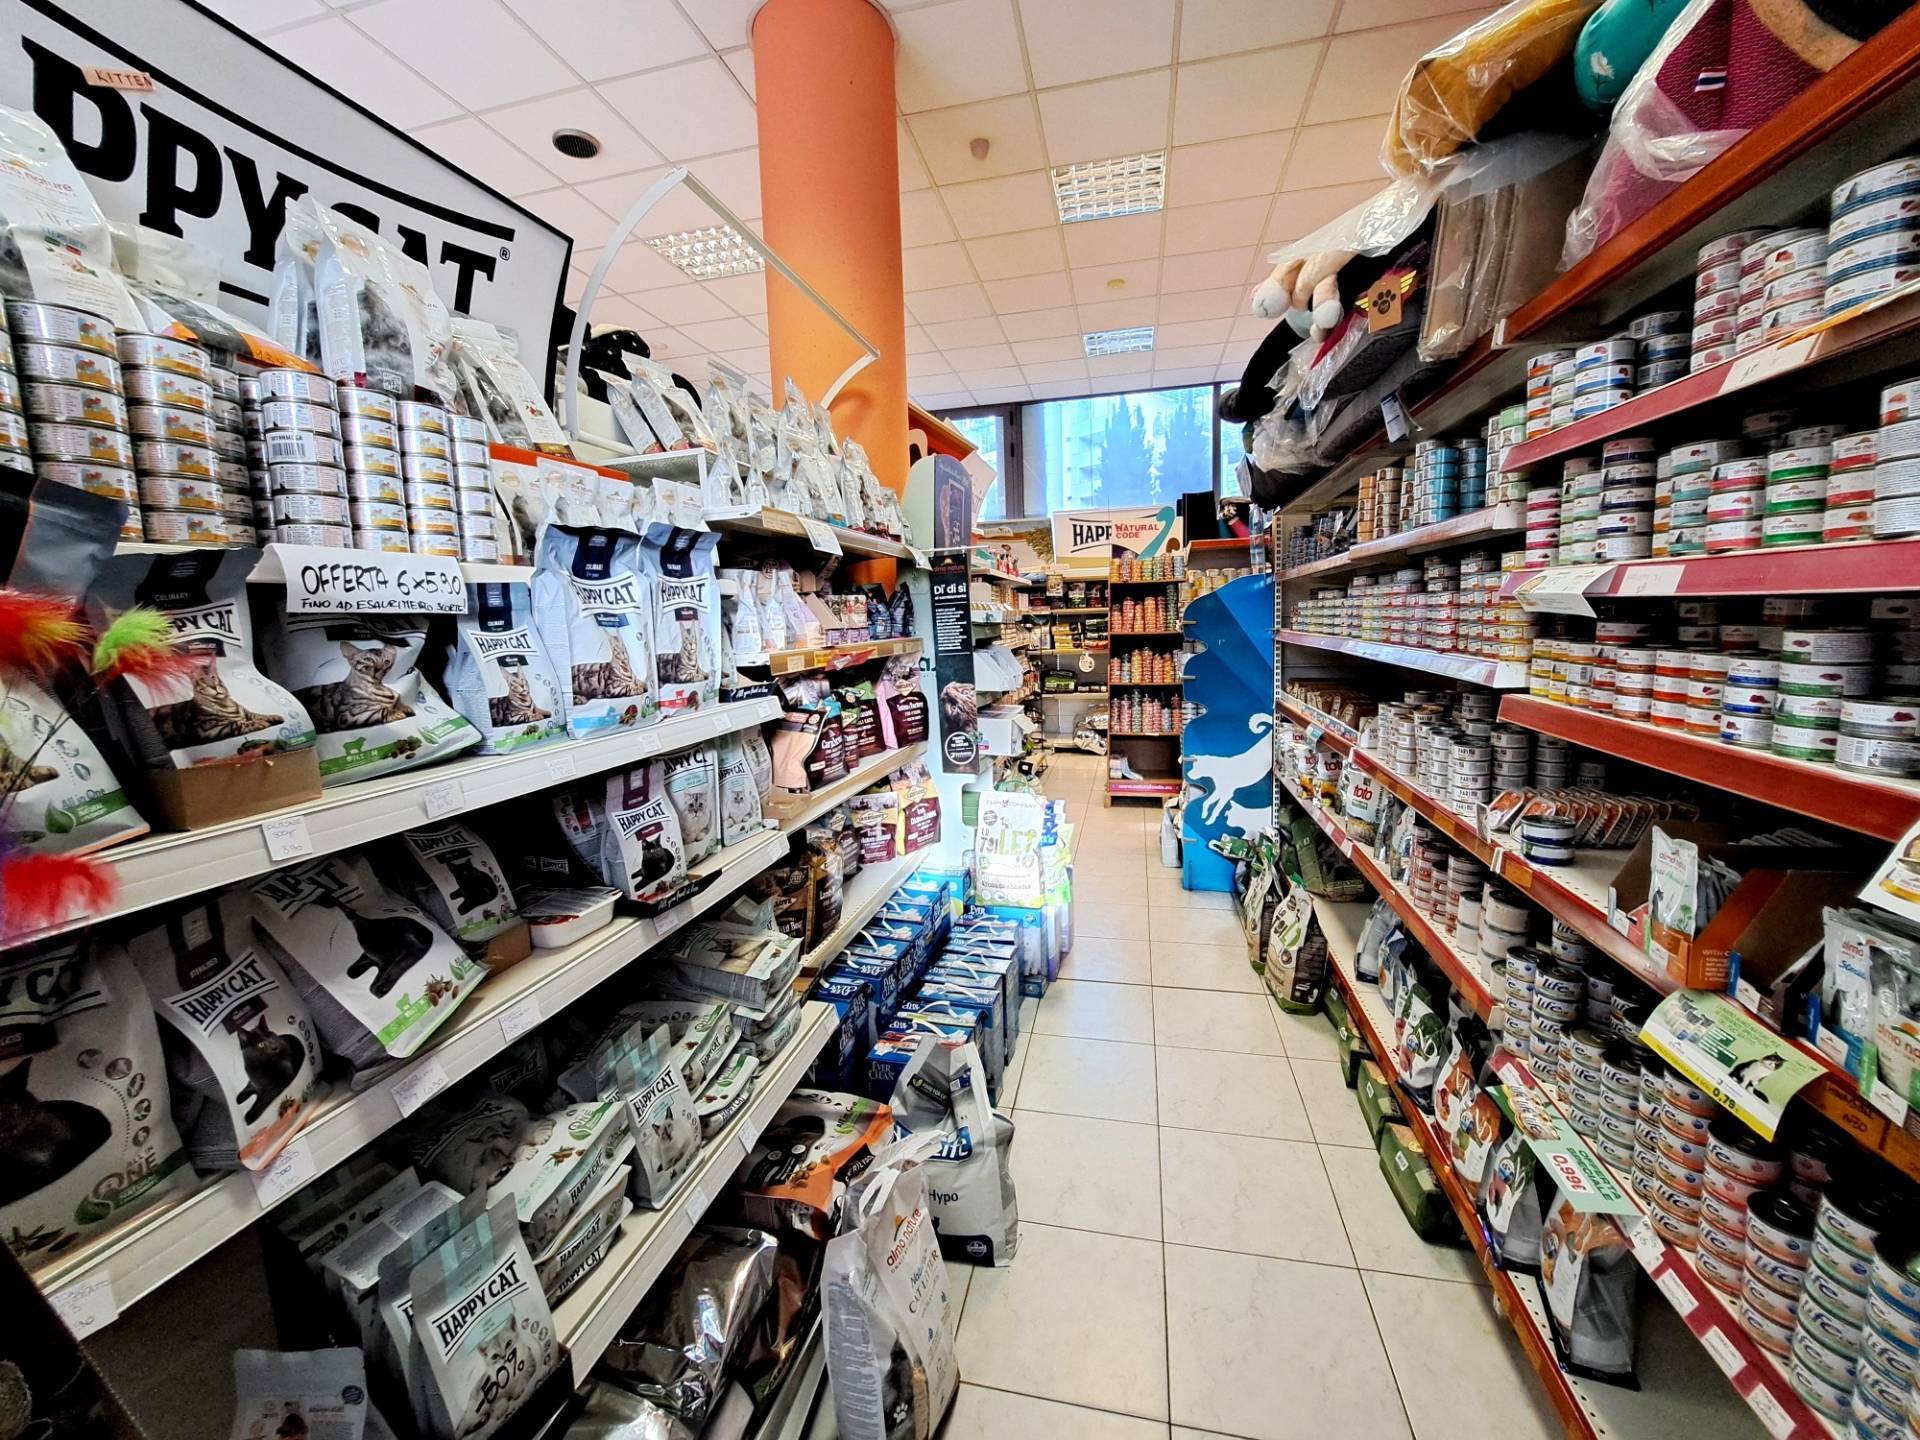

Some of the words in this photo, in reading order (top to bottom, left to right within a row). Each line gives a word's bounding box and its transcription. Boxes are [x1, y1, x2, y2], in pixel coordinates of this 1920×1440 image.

[95, 69, 153, 87] KITTEN
[1115, 523, 1160, 533] NATURAL
[302, 564, 388, 595] OFFERTA
[946, 583, 957, 594] di
[300, 598, 331, 609] FINO
[336, 601, 353, 611] AD
[604, 582, 638, 606] CAT
[204, 609, 234, 634] CAT
[475, 637, 508, 654] HAPPY
[509, 633, 533, 650] CAT
[1353, 784, 1373, 801] toto
[618, 813, 646, 832] HAPPY
[646, 802, 666, 820] CAT
[446, 831, 469, 845] CAT
[179, 986, 228, 1025] HAPPY
[228, 960, 267, 994] CAT
[1542, 978, 1570, 993] life
[1537, 997, 1563, 1012] life
[872, 1062, 891, 1074] EVER
[1571, 1063, 1597, 1082] life
[1603, 1066, 1630, 1085] life
[632, 1089, 656, 1119] HAPPY
[656, 1070, 676, 1094] CAT
[1570, 1107, 1596, 1127] life
[1567, 1147, 1615, 1201] SPECIALE
[1579, 1150, 1622, 1200] OFFERTA
[570, 1172, 592, 1204] HAPPY
[929, 1190, 959, 1206] Hypo
[1657, 1183, 1689, 1208] life
[1652, 1207, 1679, 1232] life
[886, 1236, 906, 1267] almo
[904, 1208, 922, 1240] nature
[560, 1237, 587, 1267] HAPPY
[1755, 1255, 1800, 1285] life
[436, 1289, 485, 1349] HAPPY
[488, 1259, 520, 1298] CAT
[1801, 1299, 1842, 1336] life
[1867, 1333, 1912, 1371] life
[475, 1347, 525, 1414] -50%
[1858, 1364, 1903, 1405] life
